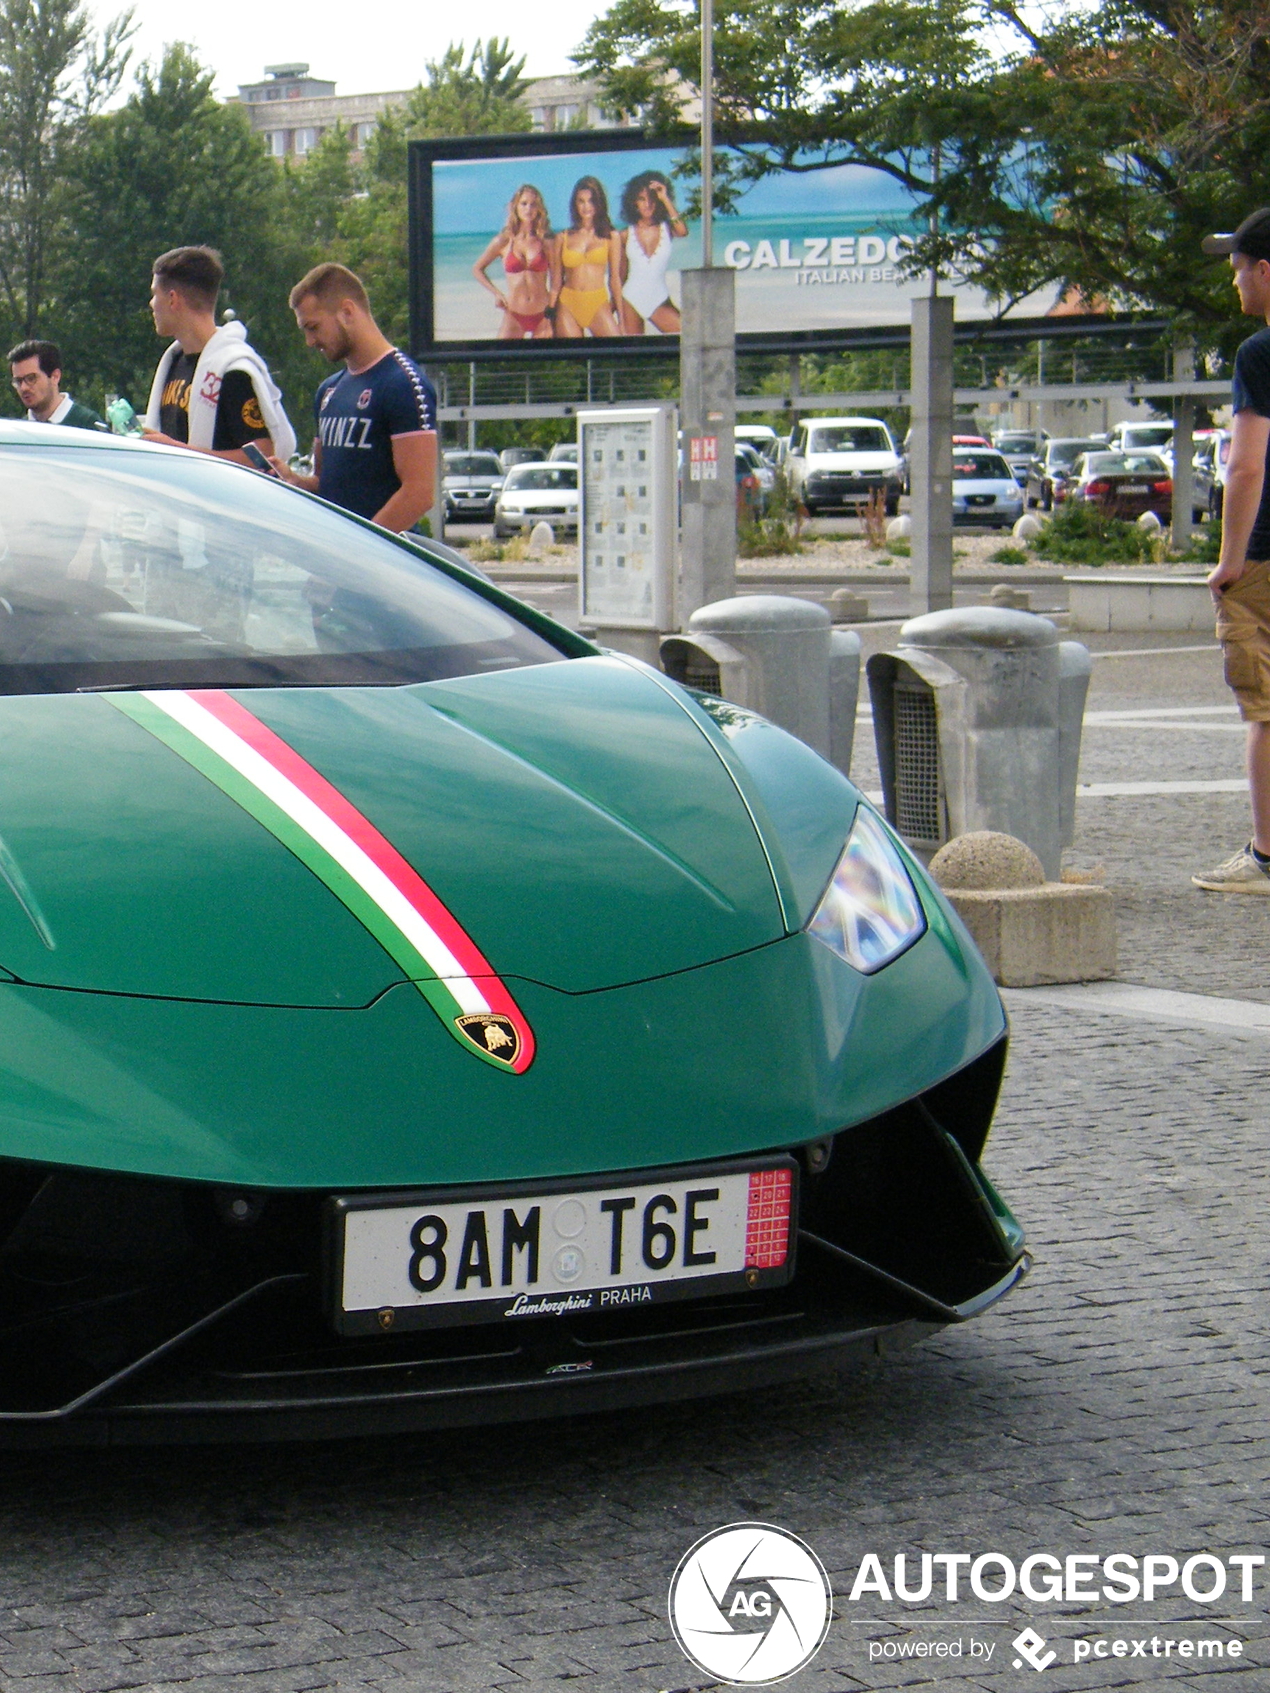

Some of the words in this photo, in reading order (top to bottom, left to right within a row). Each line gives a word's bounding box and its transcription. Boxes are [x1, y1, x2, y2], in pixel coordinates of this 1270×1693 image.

[724, 234, 982, 270] CALZEDO
[795, 269, 865, 285] ITALIAN
[408, 1206, 541, 1293] 8AM
[600, 1189, 720, 1276] T6E
[504, 1294, 593, 1316] Lamborghini
[600, 1286, 652, 1306] PRAHA
